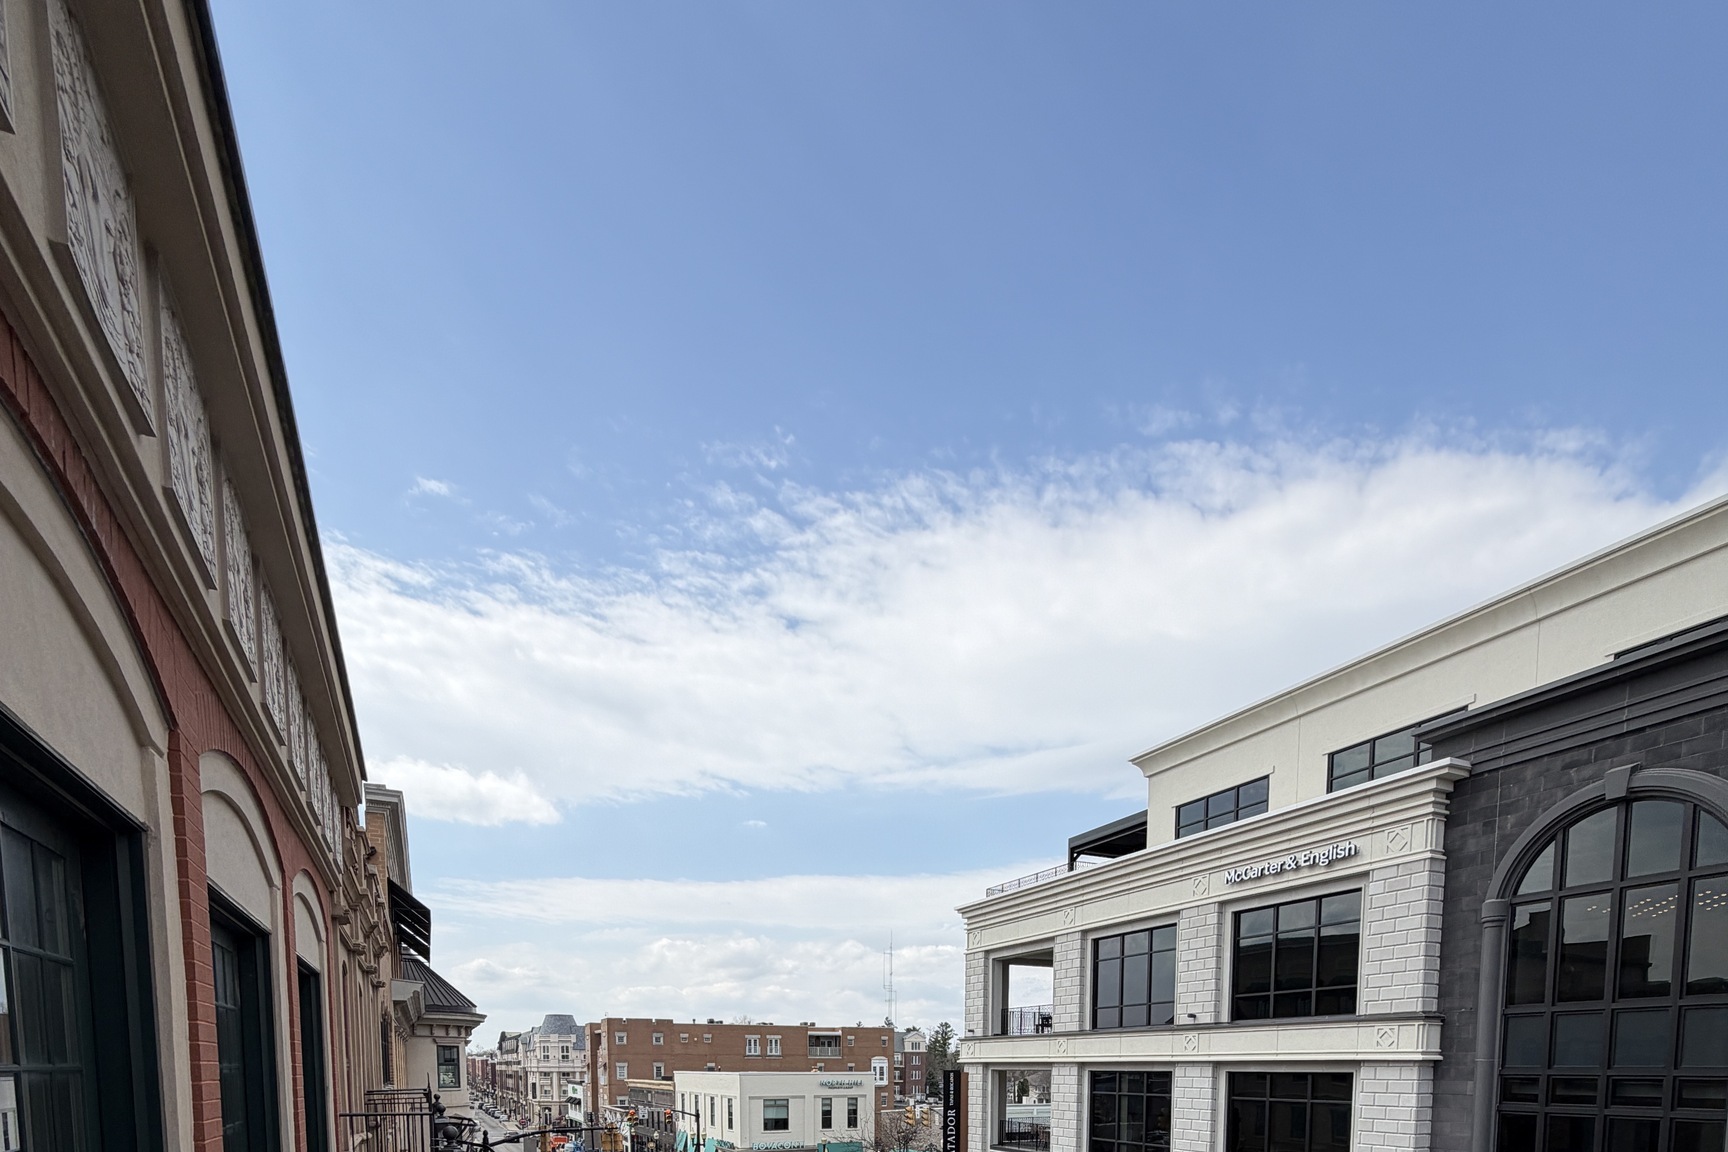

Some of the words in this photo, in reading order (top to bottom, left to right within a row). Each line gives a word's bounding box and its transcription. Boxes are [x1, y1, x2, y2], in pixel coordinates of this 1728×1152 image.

[1224, 859, 1285, 885] McCarter
[1286, 855, 1297, 870] &
[1301, 841, 1358, 866] English
